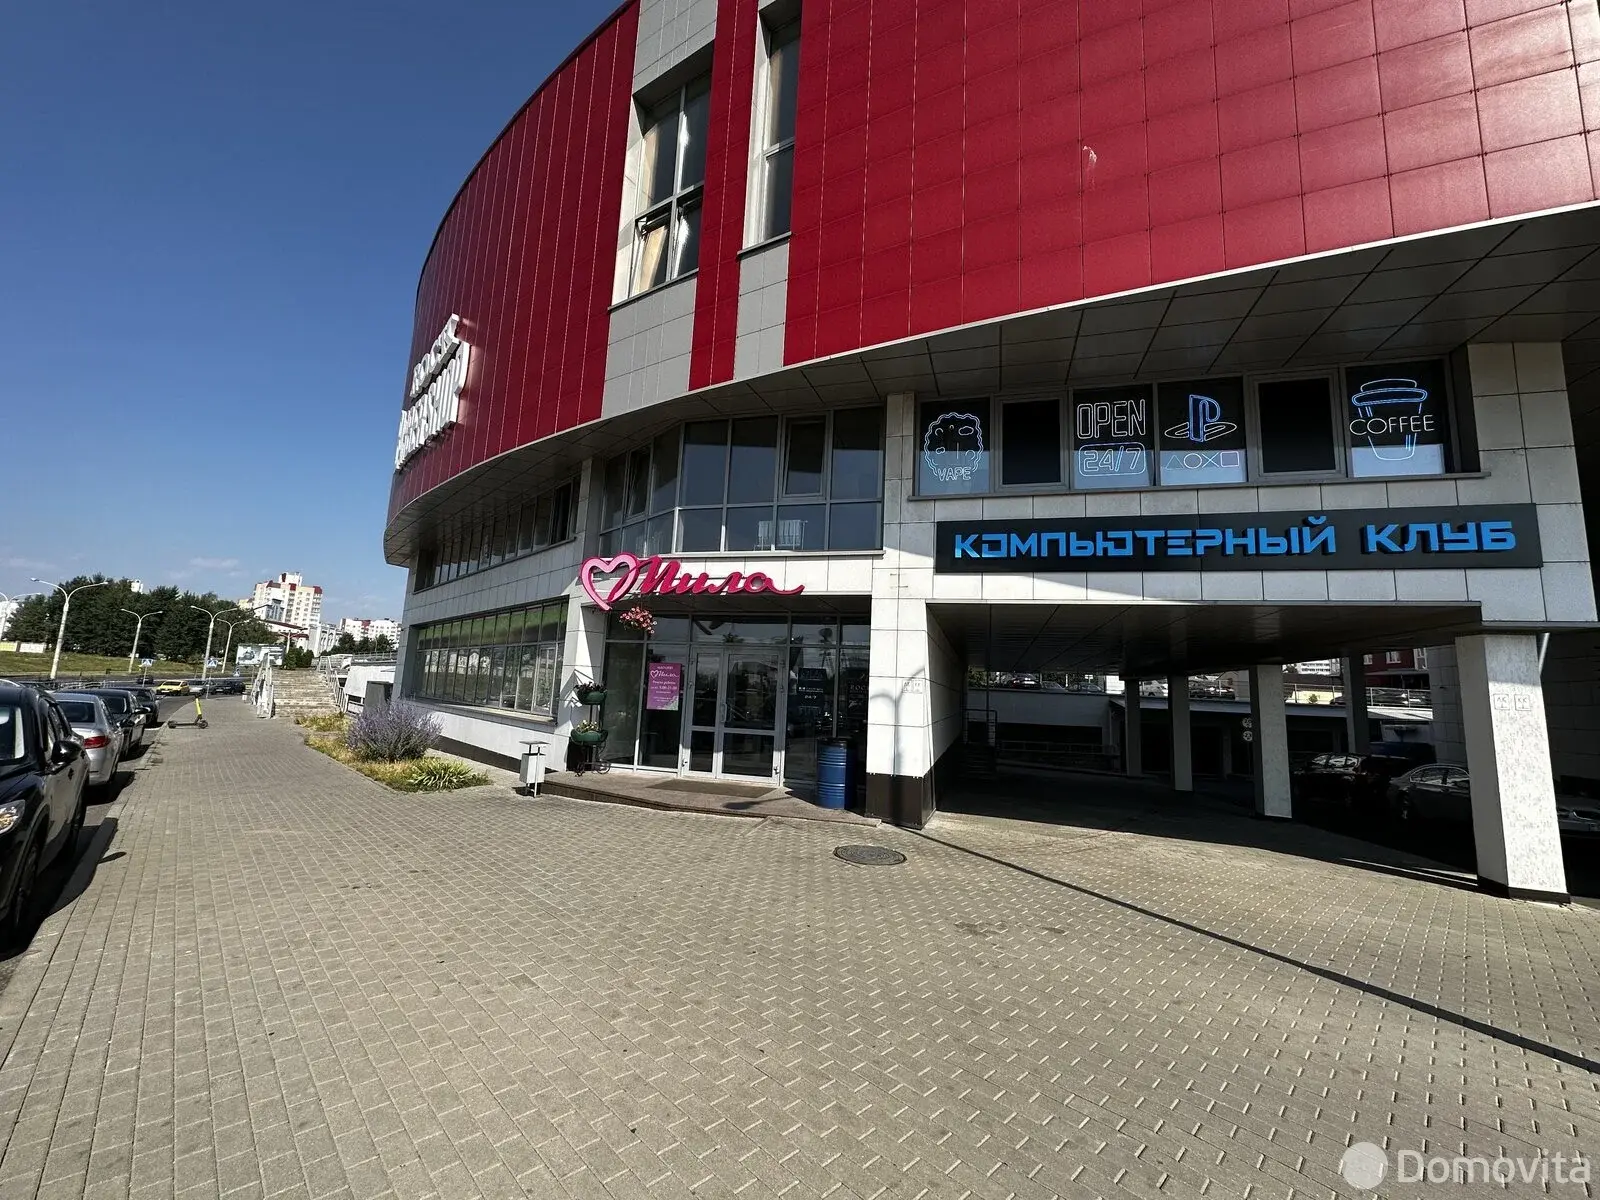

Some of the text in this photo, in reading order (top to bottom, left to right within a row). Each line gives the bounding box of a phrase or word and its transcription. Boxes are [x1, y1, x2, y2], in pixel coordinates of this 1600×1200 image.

[394, 341, 471, 470] BERSHOP
[1076, 399, 1146, 440] OPEN
[1349, 414, 1435, 436] COFFEE
[937, 466, 972, 482] VAPE
[1083, 446, 1142, 472] 24/7
[953, 516, 1517, 560] КОМПЬЮТЕРНЫЙ КЛУБ
[636, 555, 805, 595] Мила
